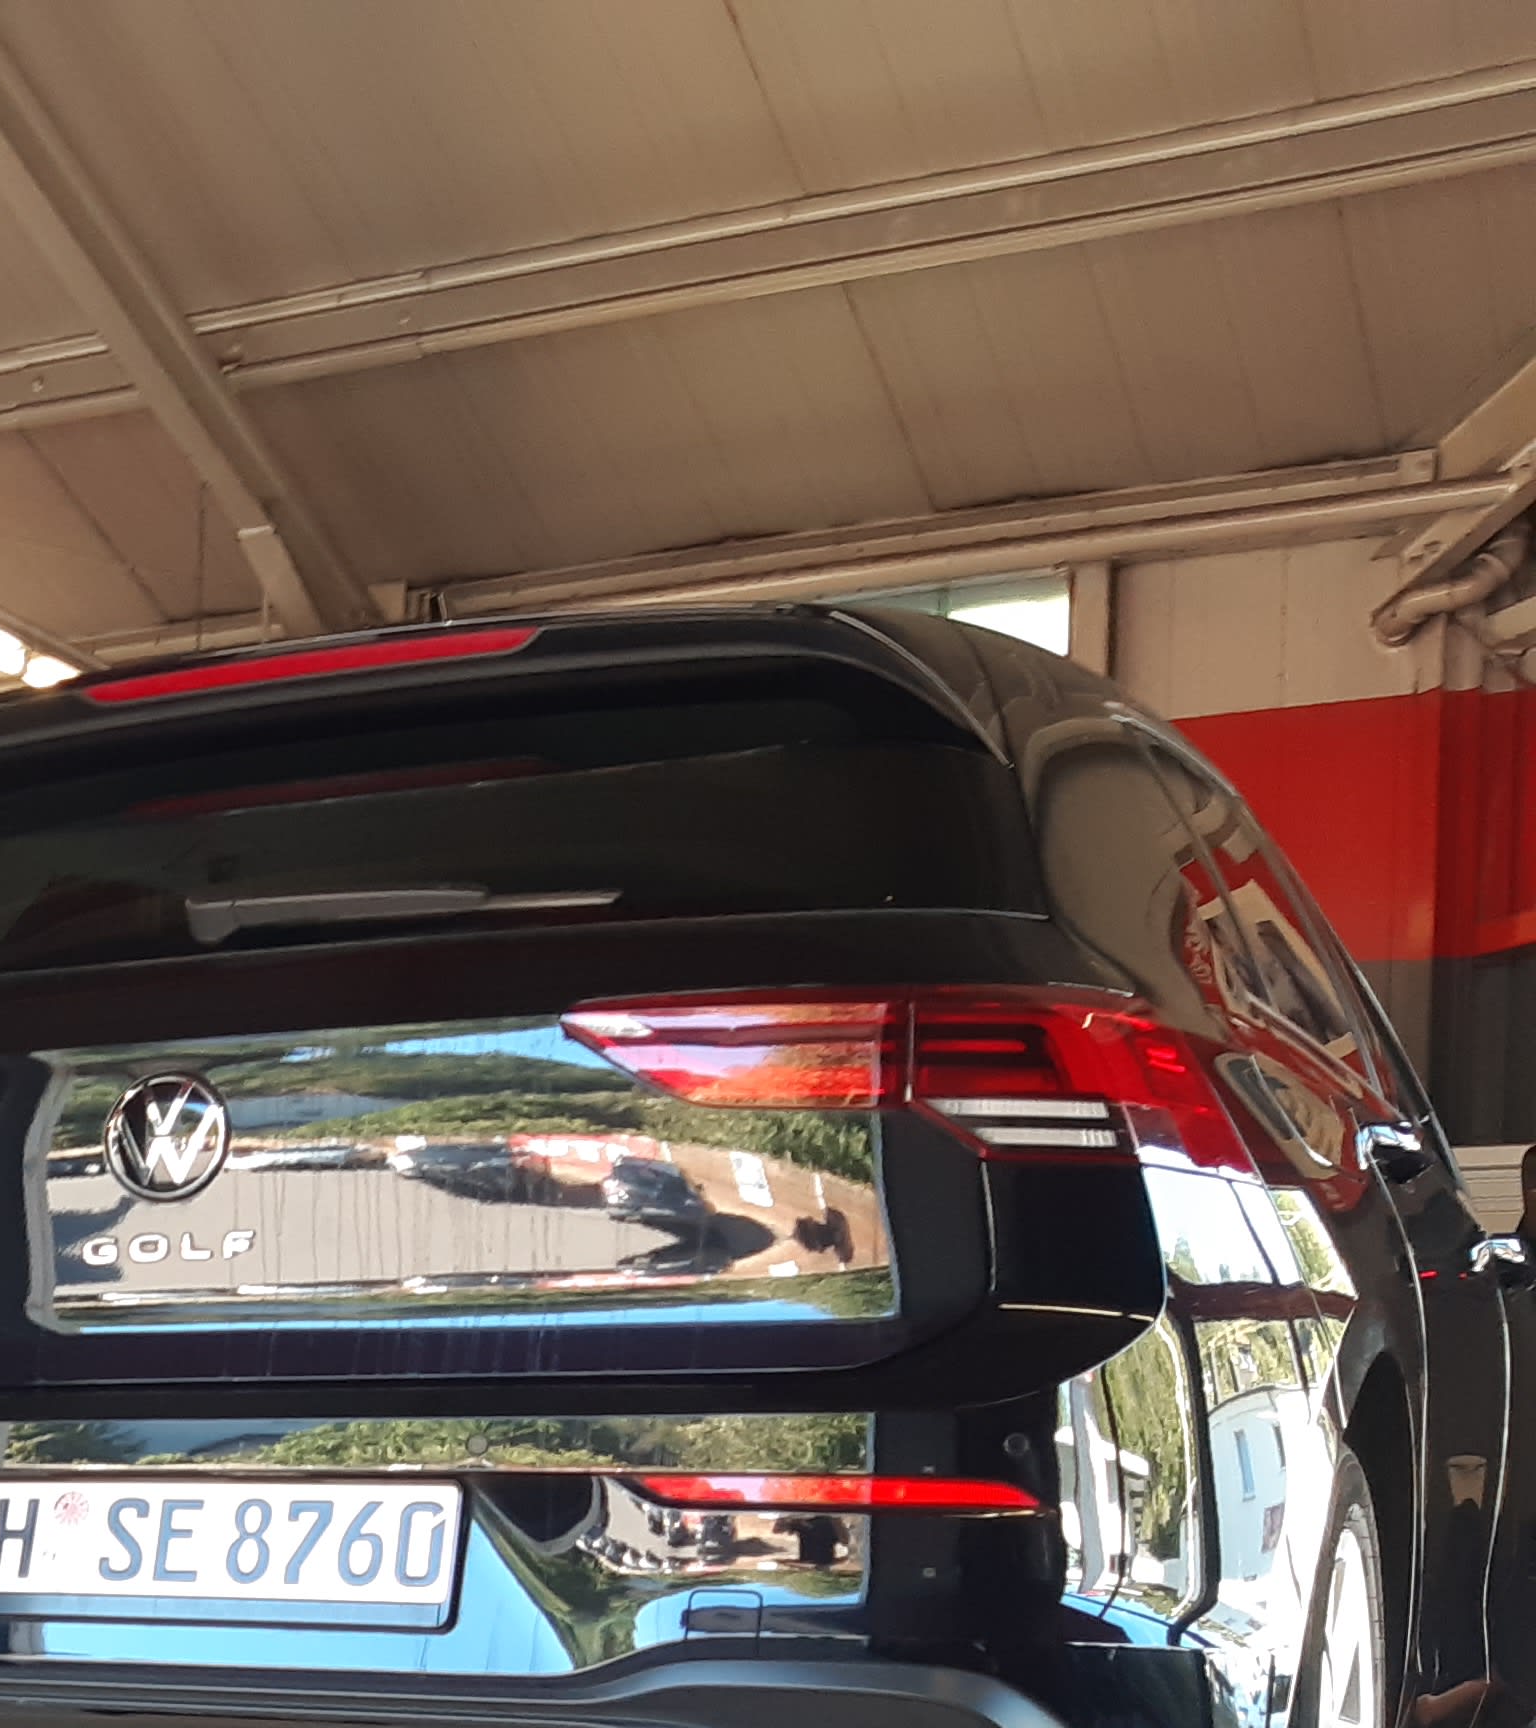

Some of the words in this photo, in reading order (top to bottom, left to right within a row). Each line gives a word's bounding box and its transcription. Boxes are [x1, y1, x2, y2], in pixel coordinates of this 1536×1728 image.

[81, 1229, 256, 1266] GOLF
[98, 1496, 205, 1582] SE
[225, 1497, 447, 1588] 8760
